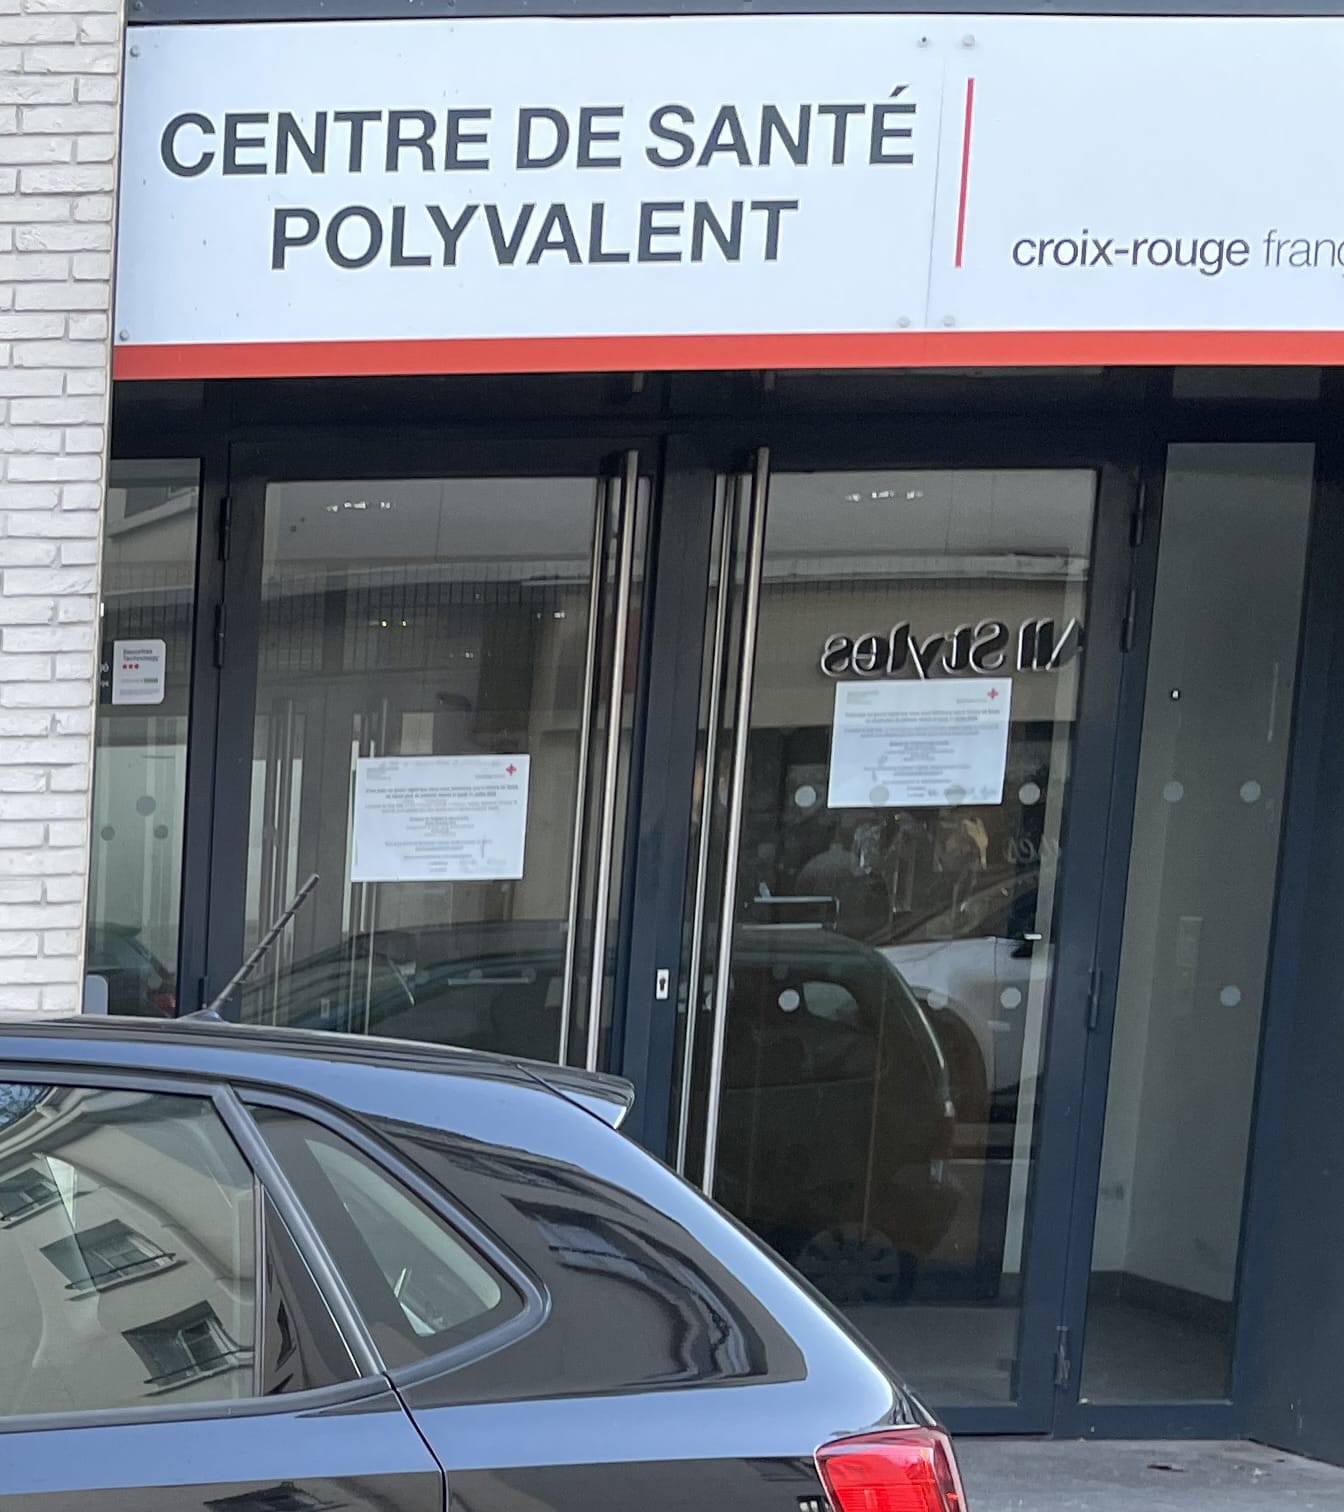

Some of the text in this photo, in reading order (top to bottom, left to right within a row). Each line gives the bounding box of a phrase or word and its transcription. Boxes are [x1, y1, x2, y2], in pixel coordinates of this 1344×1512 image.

[160, 85, 918, 178] CENTRE DE SANTÉ
[271, 199, 800, 270] POLYVALENT
[1012, 228, 1250, 277] croix-rouge
